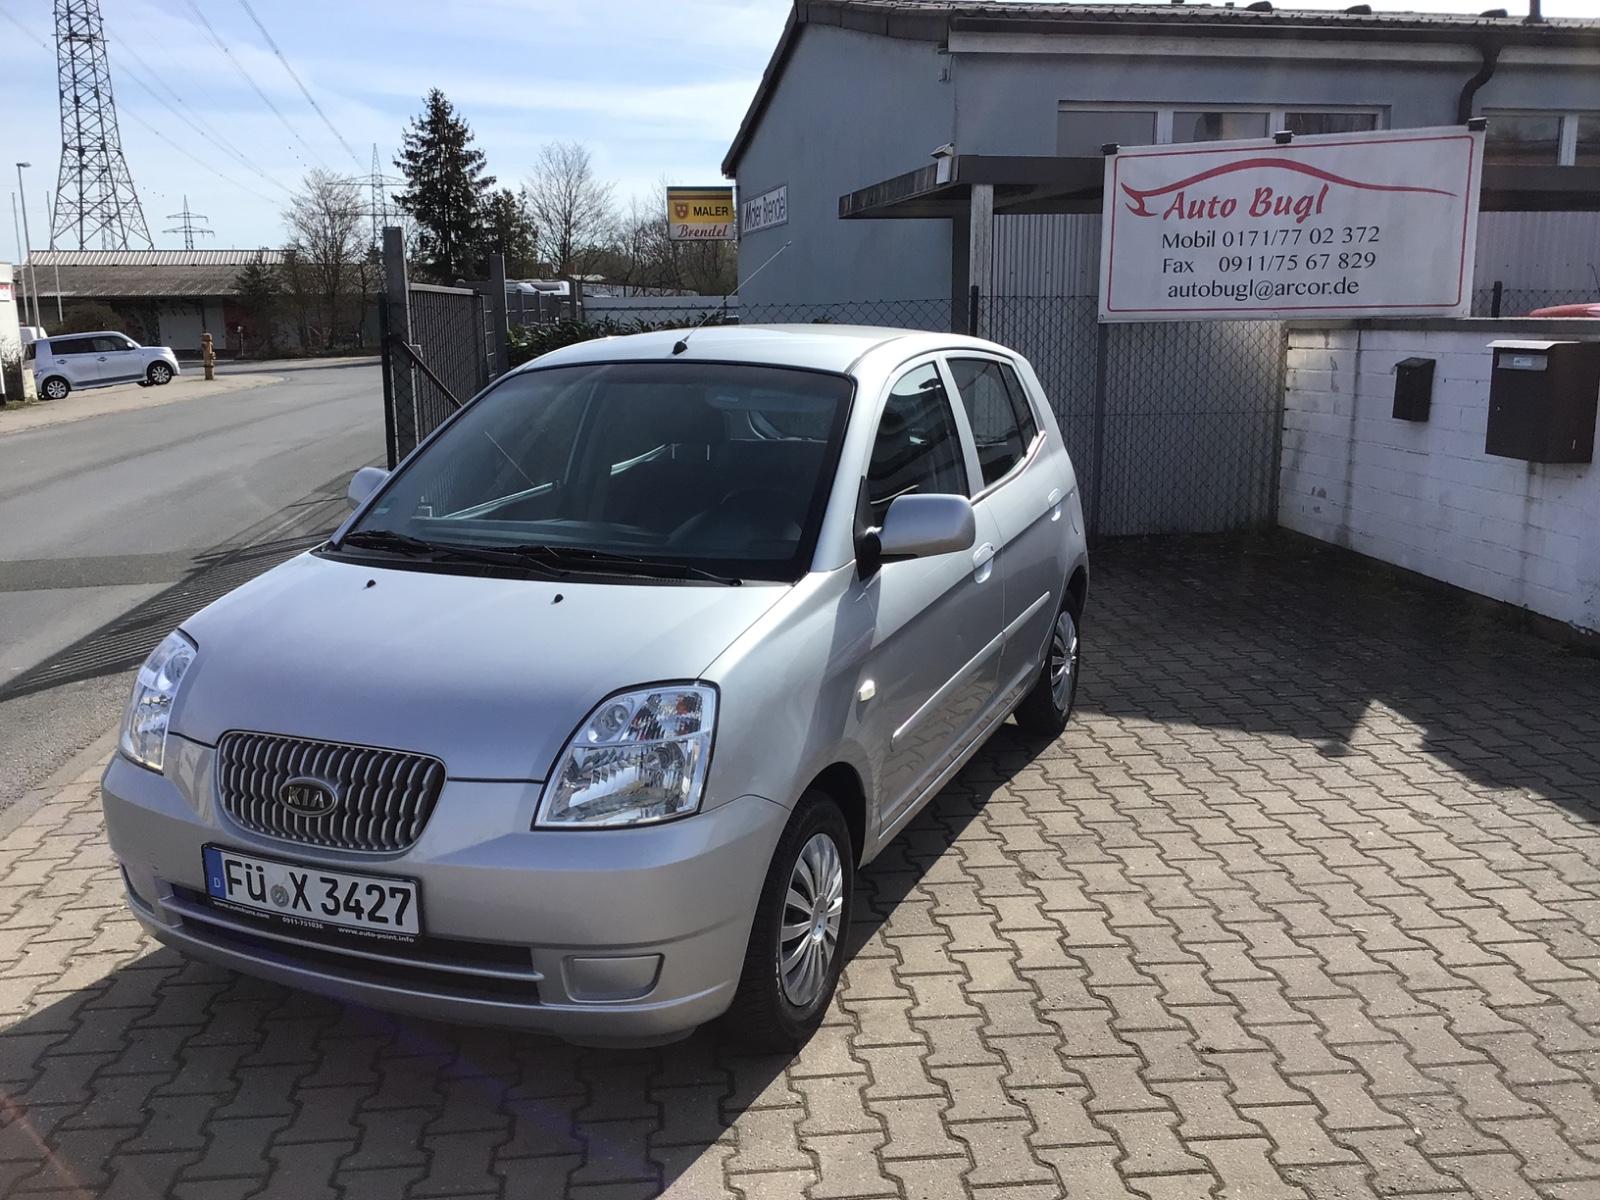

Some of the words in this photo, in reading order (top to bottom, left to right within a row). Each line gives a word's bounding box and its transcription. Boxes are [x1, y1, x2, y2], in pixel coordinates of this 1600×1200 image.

[693, 206, 729, 216] MALER
[1162, 191, 1236, 221] Auto
[1249, 182, 1330, 224] Bugl
[678, 224, 728, 238] Brendel
[1162, 230, 1215, 249] Mobil
[1222, 229, 1301, 248] 0171/77
[1309, 228, 1334, 245] 02
[1342, 225, 1380, 244] 372
[1162, 257, 1194, 274] Fax
[1218, 255, 1298, 273] 0911/75
[1305, 254, 1329, 270] 67
[1338, 251, 1377, 269] 829
[1168, 277, 1360, 301] autobugl@arcor.de
[288, 786, 325, 808] KIA
[225, 859, 267, 903] FÜ
[320, 877, 412, 926] 3427
